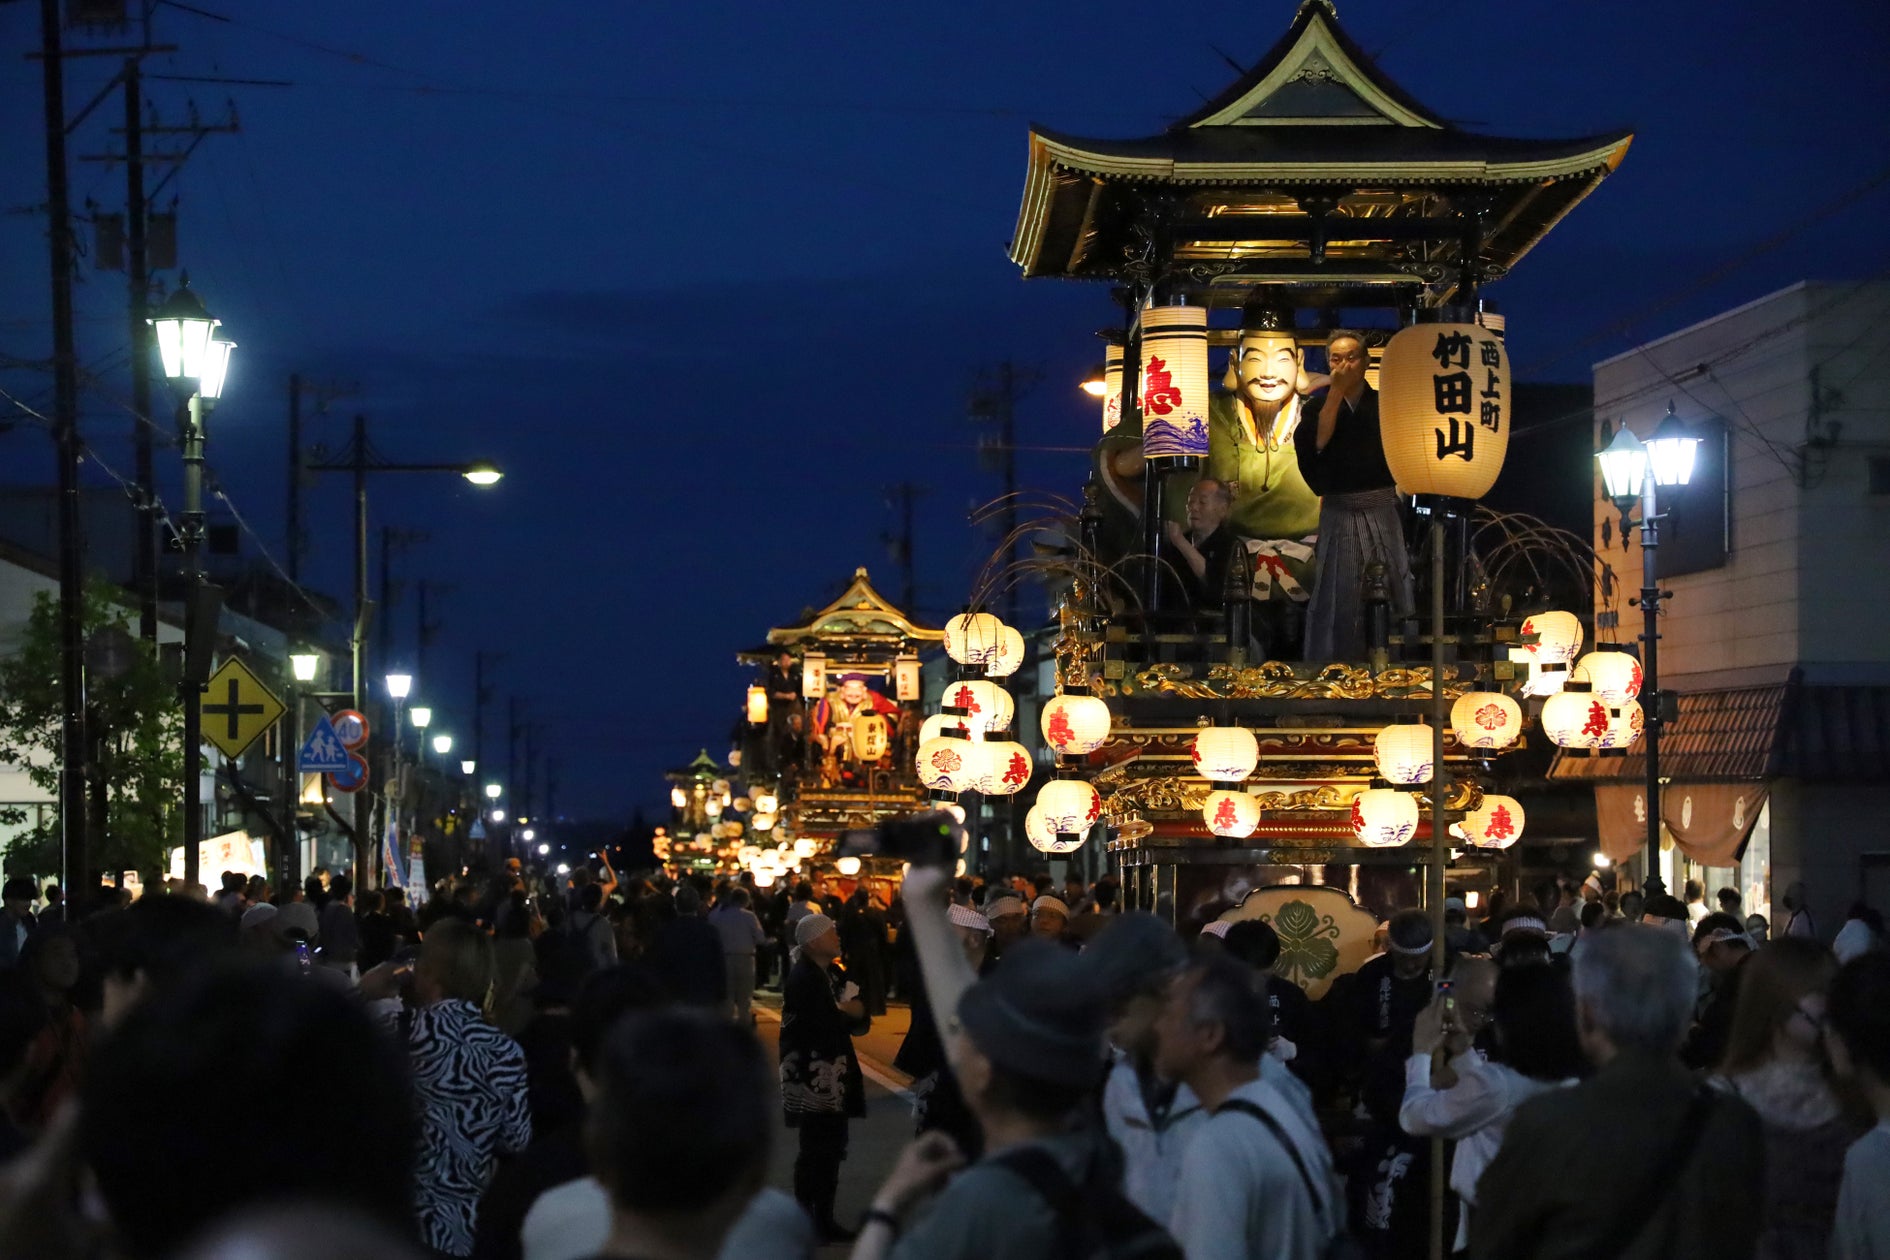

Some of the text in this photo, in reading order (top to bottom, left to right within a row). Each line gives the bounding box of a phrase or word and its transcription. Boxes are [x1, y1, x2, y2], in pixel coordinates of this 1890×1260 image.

[1432, 330, 1474, 462] 竹田山
[1479, 340, 1501, 434] 西上町
[338, 721, 359, 739] 40
